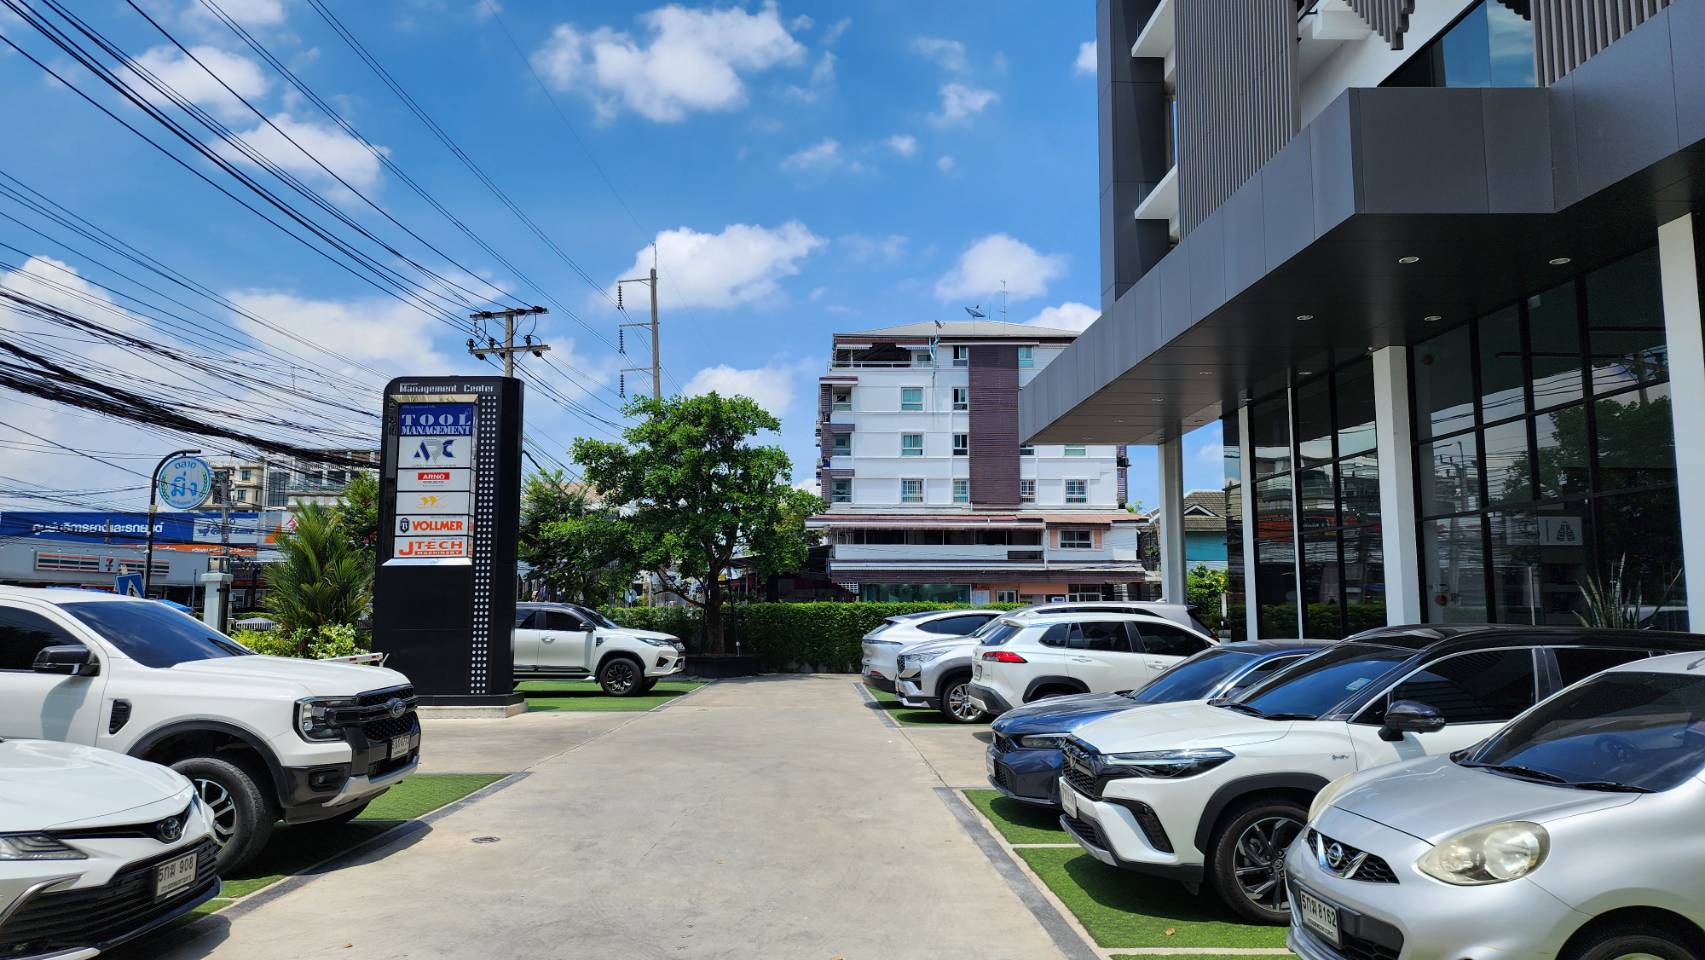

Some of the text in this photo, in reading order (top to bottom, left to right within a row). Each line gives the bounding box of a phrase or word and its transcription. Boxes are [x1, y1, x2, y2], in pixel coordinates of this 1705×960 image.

[400, 384, 494, 394] Management Center
[401, 413, 471, 425] TOOL
[401, 425, 471, 435] MANAGEMENT
[412, 520, 463, 531] VOLLMER
[179, 855, 194, 874] 908
[1317, 903, 1337, 928] 8162
